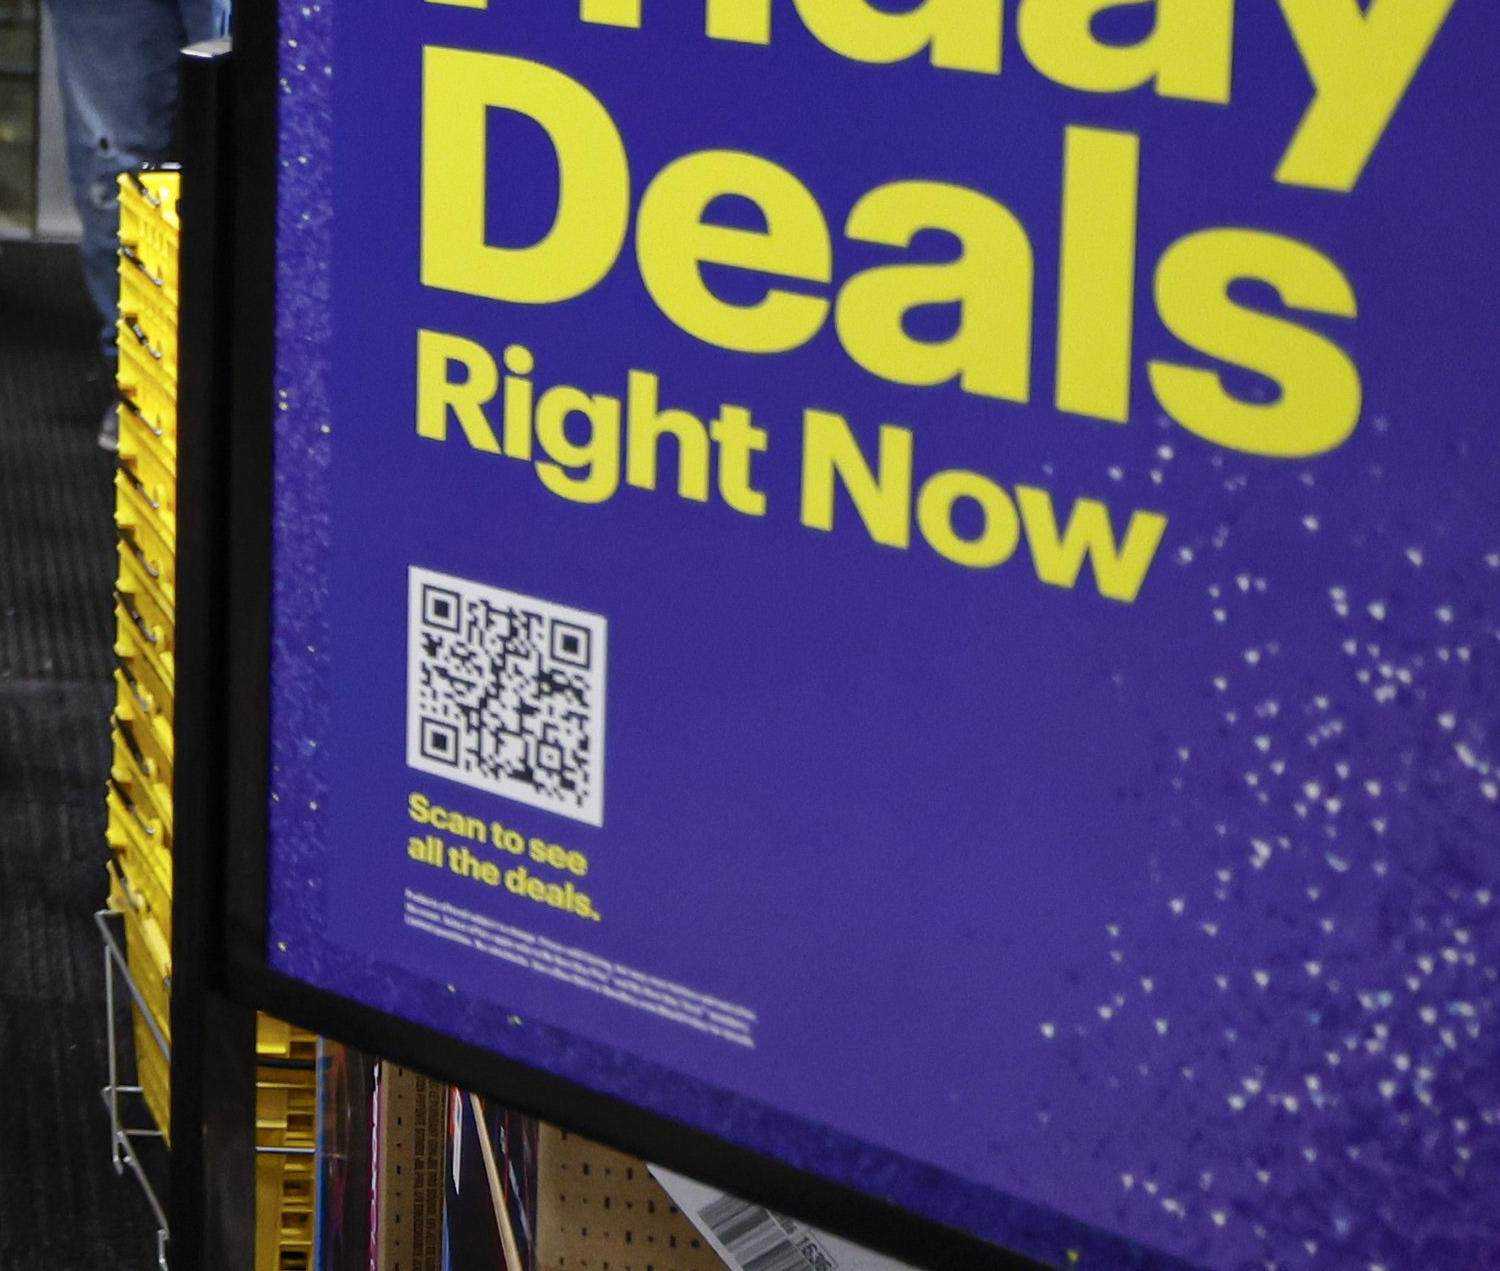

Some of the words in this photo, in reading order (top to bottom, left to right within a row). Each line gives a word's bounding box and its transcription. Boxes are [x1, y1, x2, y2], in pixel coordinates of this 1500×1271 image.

[420, 45, 1363, 459] Deals
[417, 328, 767, 516] Right
[802, 407, 1168, 604] Now
[407, 834, 444, 868] all
[448, 846, 501, 887] the
[504, 865, 601, 922] deals.
[408, 792, 488, 844] Scan
[491, 821, 525, 856] to
[528, 837, 589, 877] see
